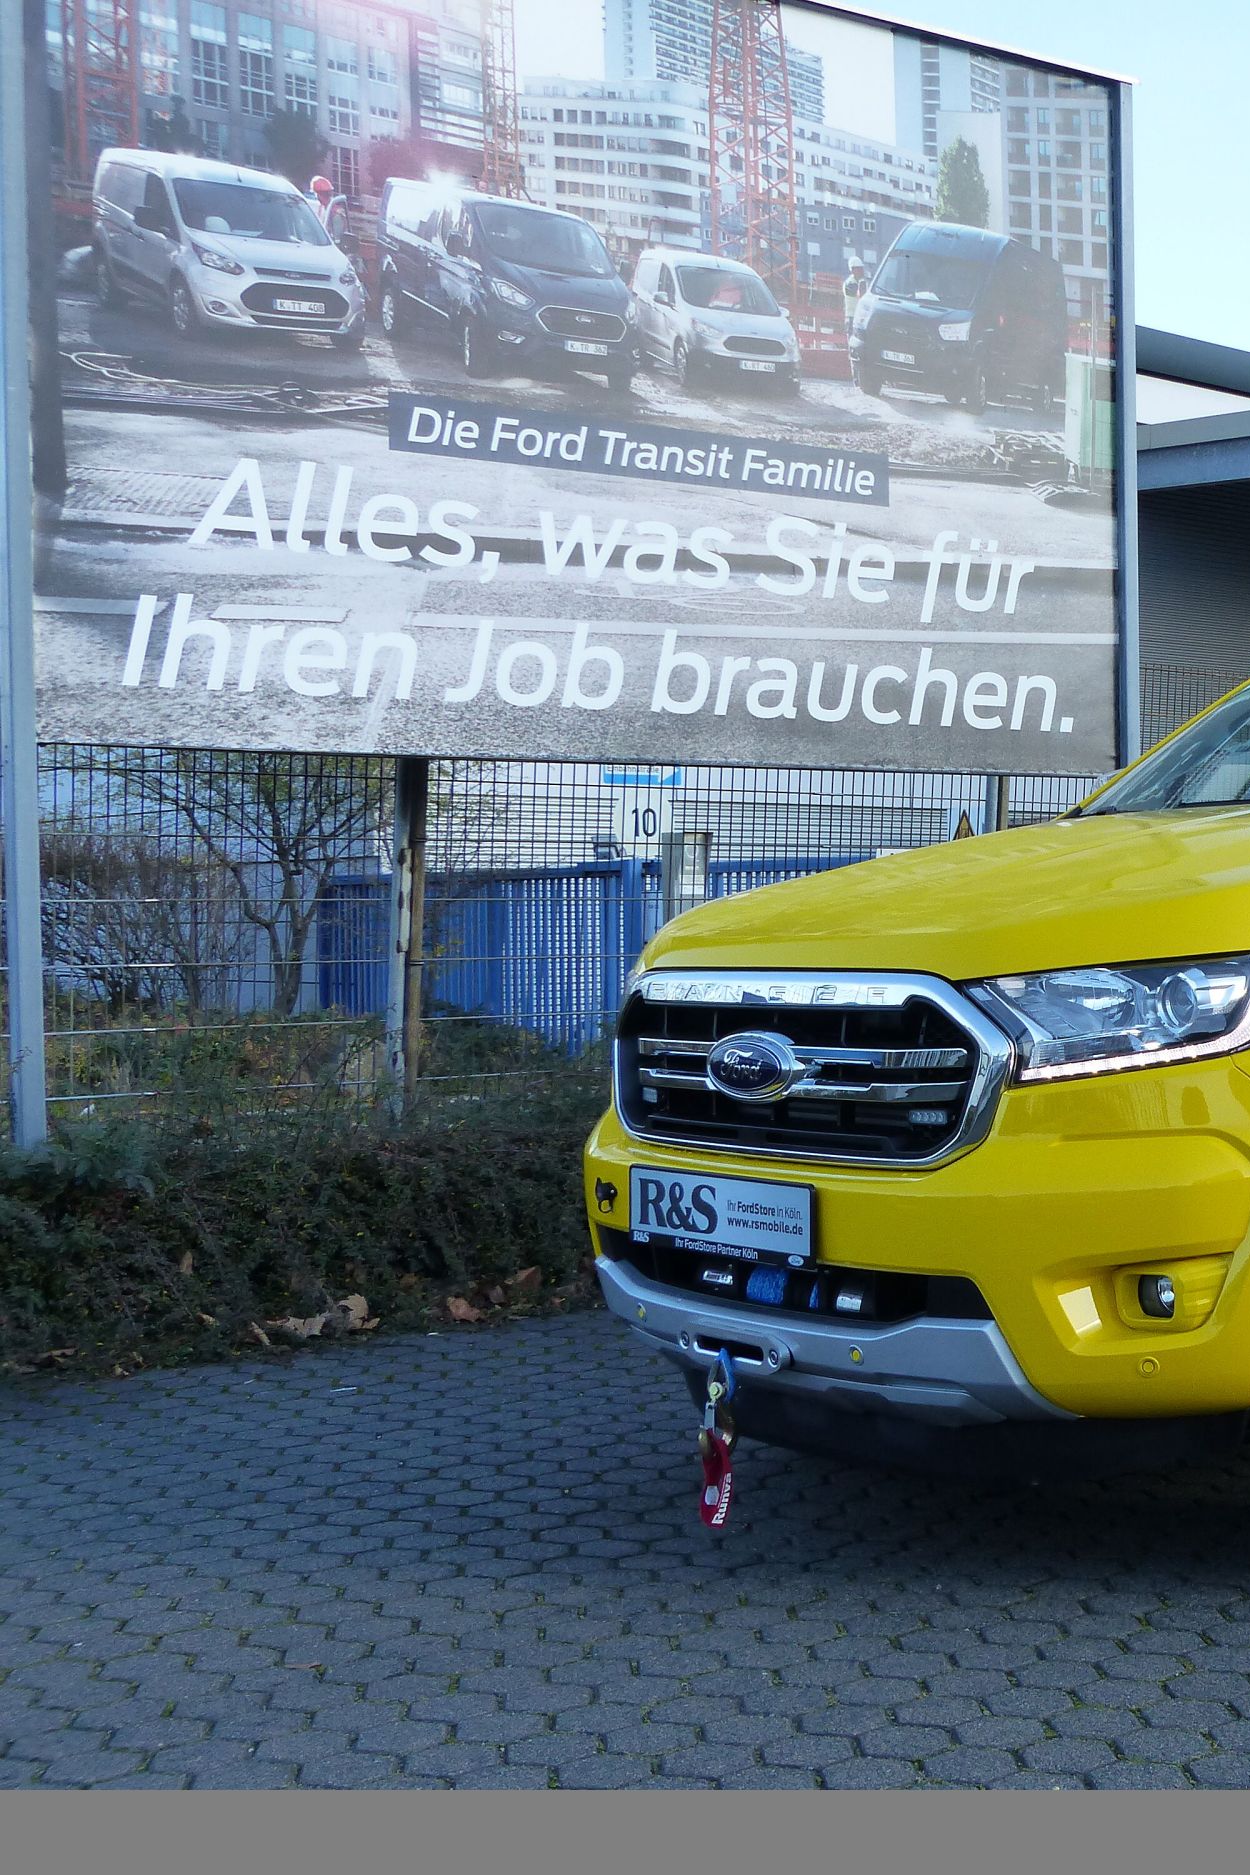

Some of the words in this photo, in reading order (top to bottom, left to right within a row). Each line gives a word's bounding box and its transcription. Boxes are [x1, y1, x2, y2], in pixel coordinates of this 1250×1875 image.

[408, 405, 478, 450] Die
[490, 417, 588, 463] Ford
[598, 429, 733, 482] Transit
[741, 447, 876, 497] Familie
[187, 457, 500, 584] Alles,
[539, 511, 736, 591] was
[755, 516, 895, 603] Sie
[920, 530, 1036, 624] für
[121, 592, 418, 700] Ihren
[444, 619, 625, 712] Job
[650, 629, 1075, 734] brauchen.
[631, 807, 657, 837] 10
[719, 1048, 764, 1081] Ford
[638, 1177, 718, 1235] R&S
[727, 1200, 737, 1212] Ihr
[737, 1200, 776, 1217] FordStore
[776, 1206, 784, 1217] in
[632, 1230, 651, 1244] R&S
[727, 1215, 804, 1236] www.rsmobile.de
[675, 1237, 684, 1248] Ihr
[684, 1238, 717, 1254] FordStore
[717, 1245, 742, 1258] Partner
[742, 1247, 758, 1261] Köln
